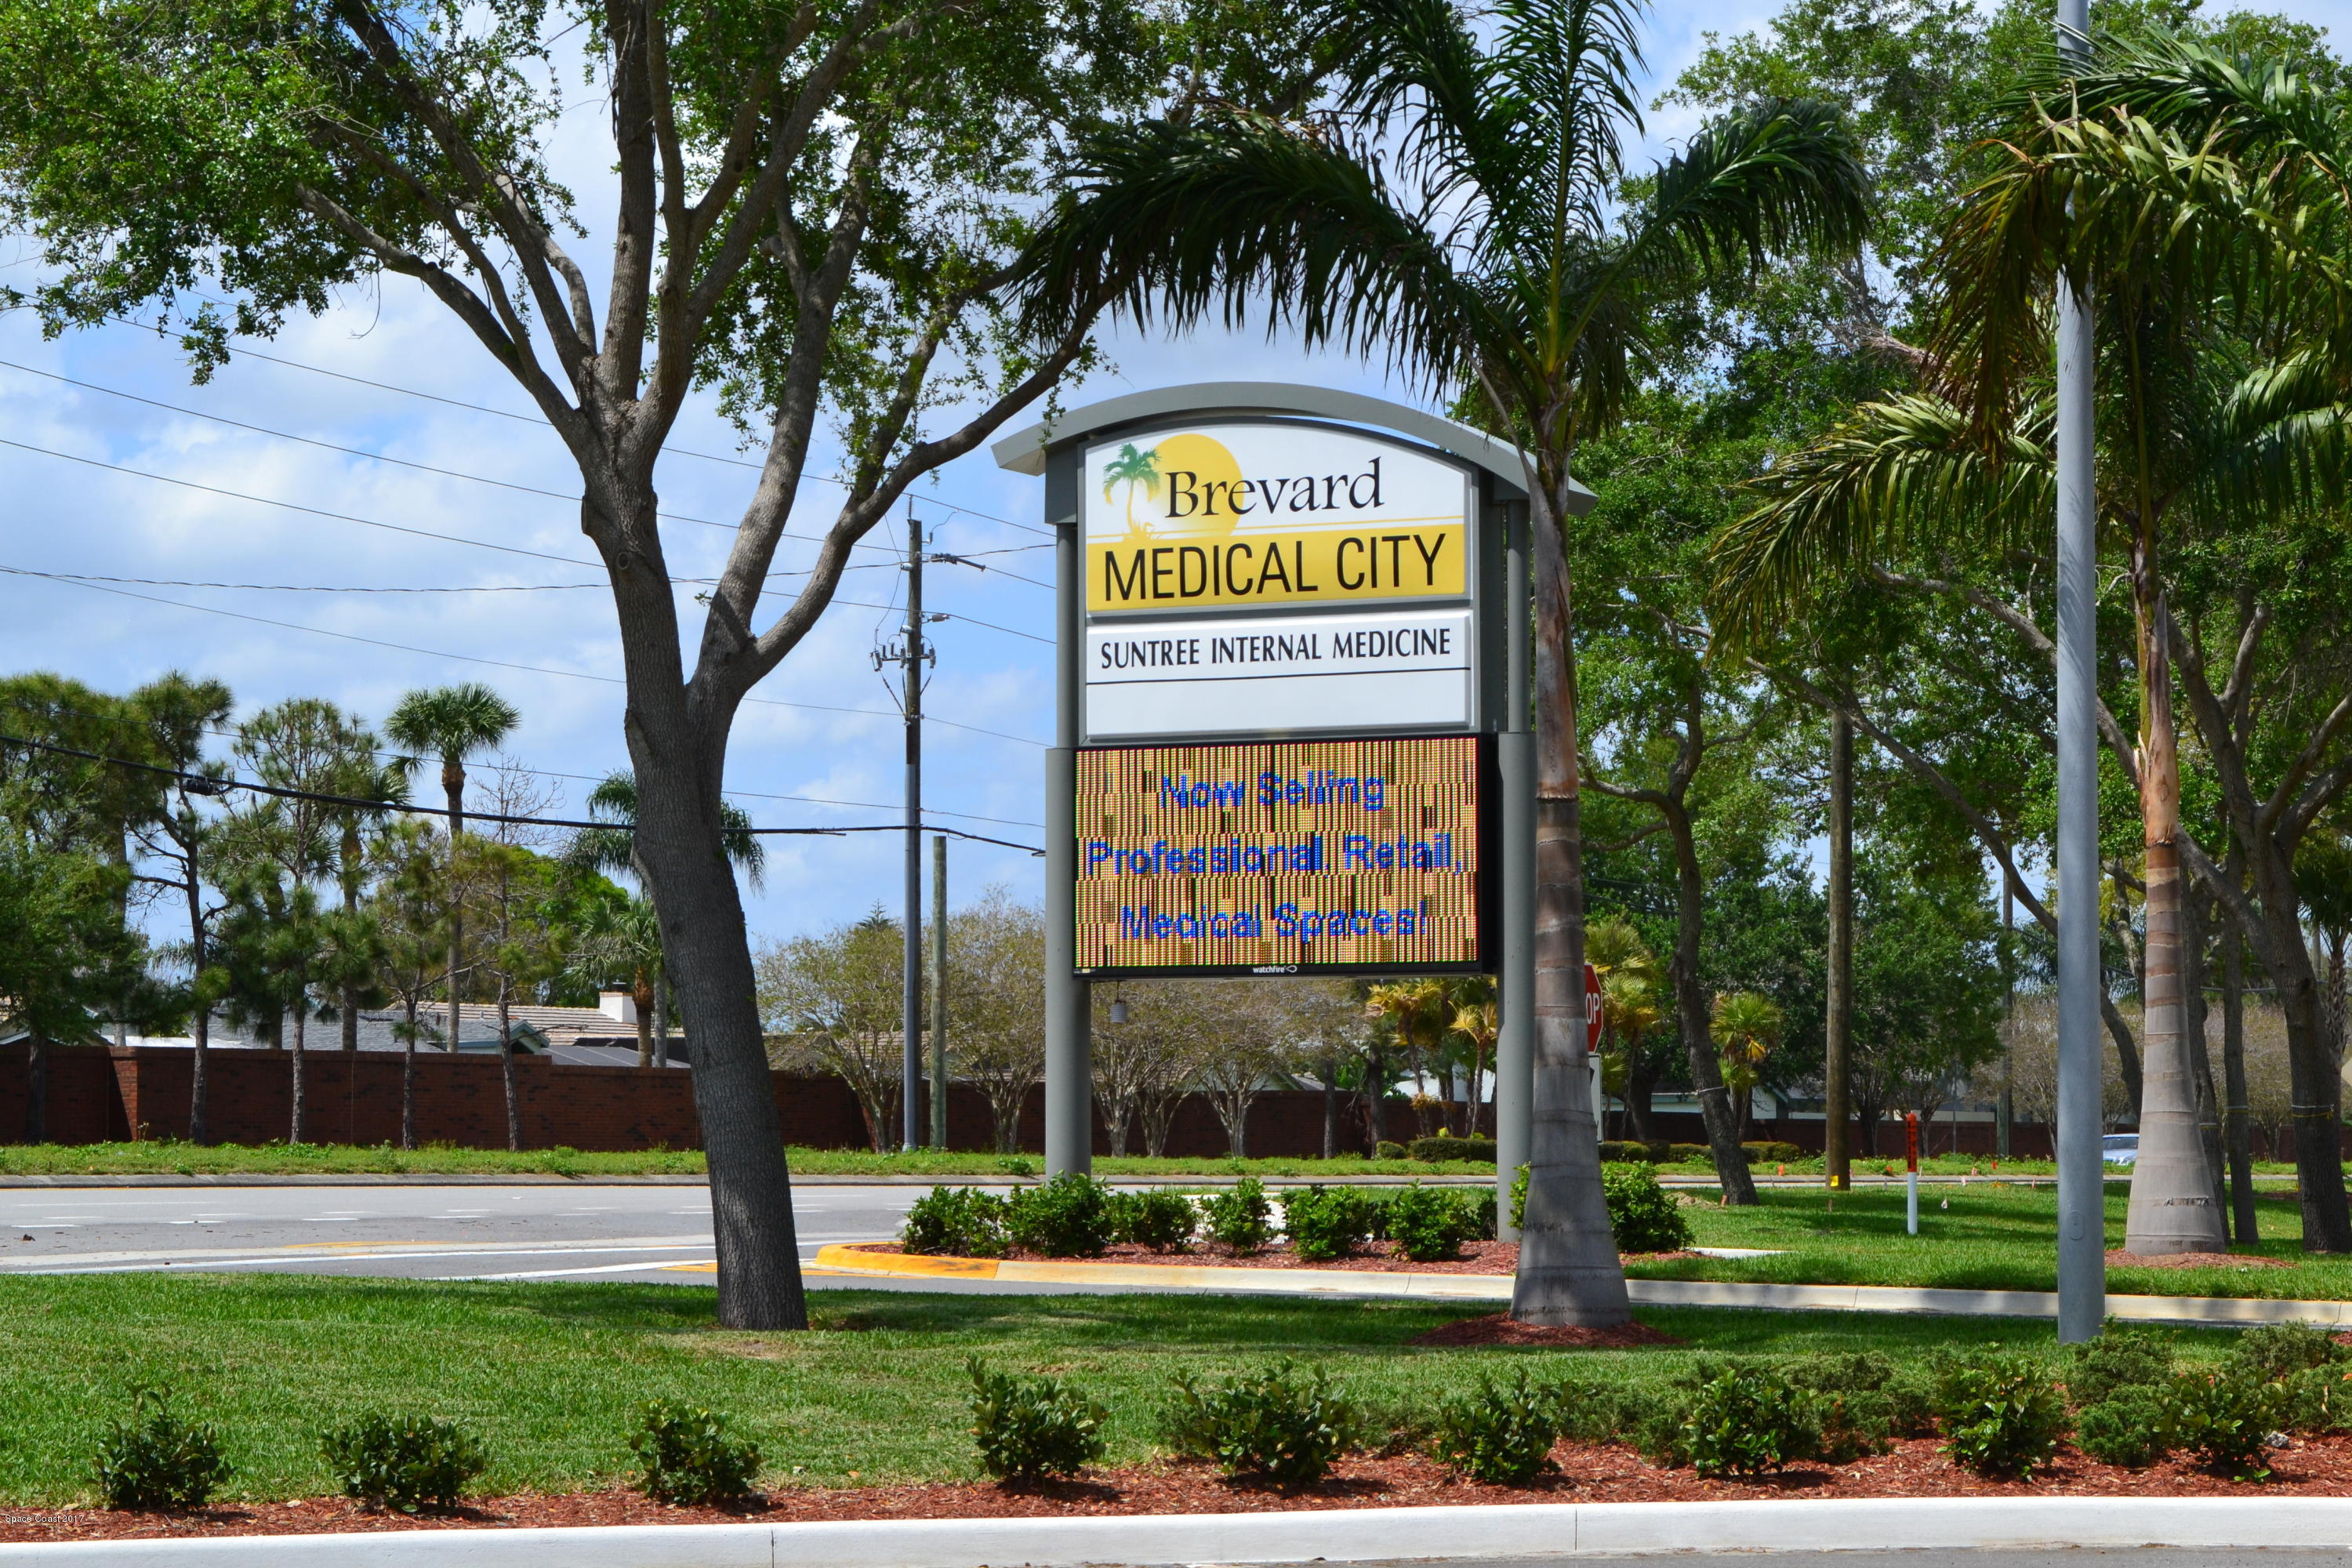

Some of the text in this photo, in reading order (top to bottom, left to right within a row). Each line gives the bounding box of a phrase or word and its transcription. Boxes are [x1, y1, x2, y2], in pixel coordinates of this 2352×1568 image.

[1166, 456, 1385, 517] Brevard
[1105, 533, 1446, 601] MEDICAL CITY
[1101, 628, 1451, 670] SUNTREE INTERNAL MEDICINE
[1160, 770, 1385, 811] Now Selling
[1344, 832, 1462, 875] Retail,
[1121, 900, 1427, 944] Medical Spaces!
[1252, 965, 1285, 974] watchfire
[1586, 993, 1600, 1024] OP
